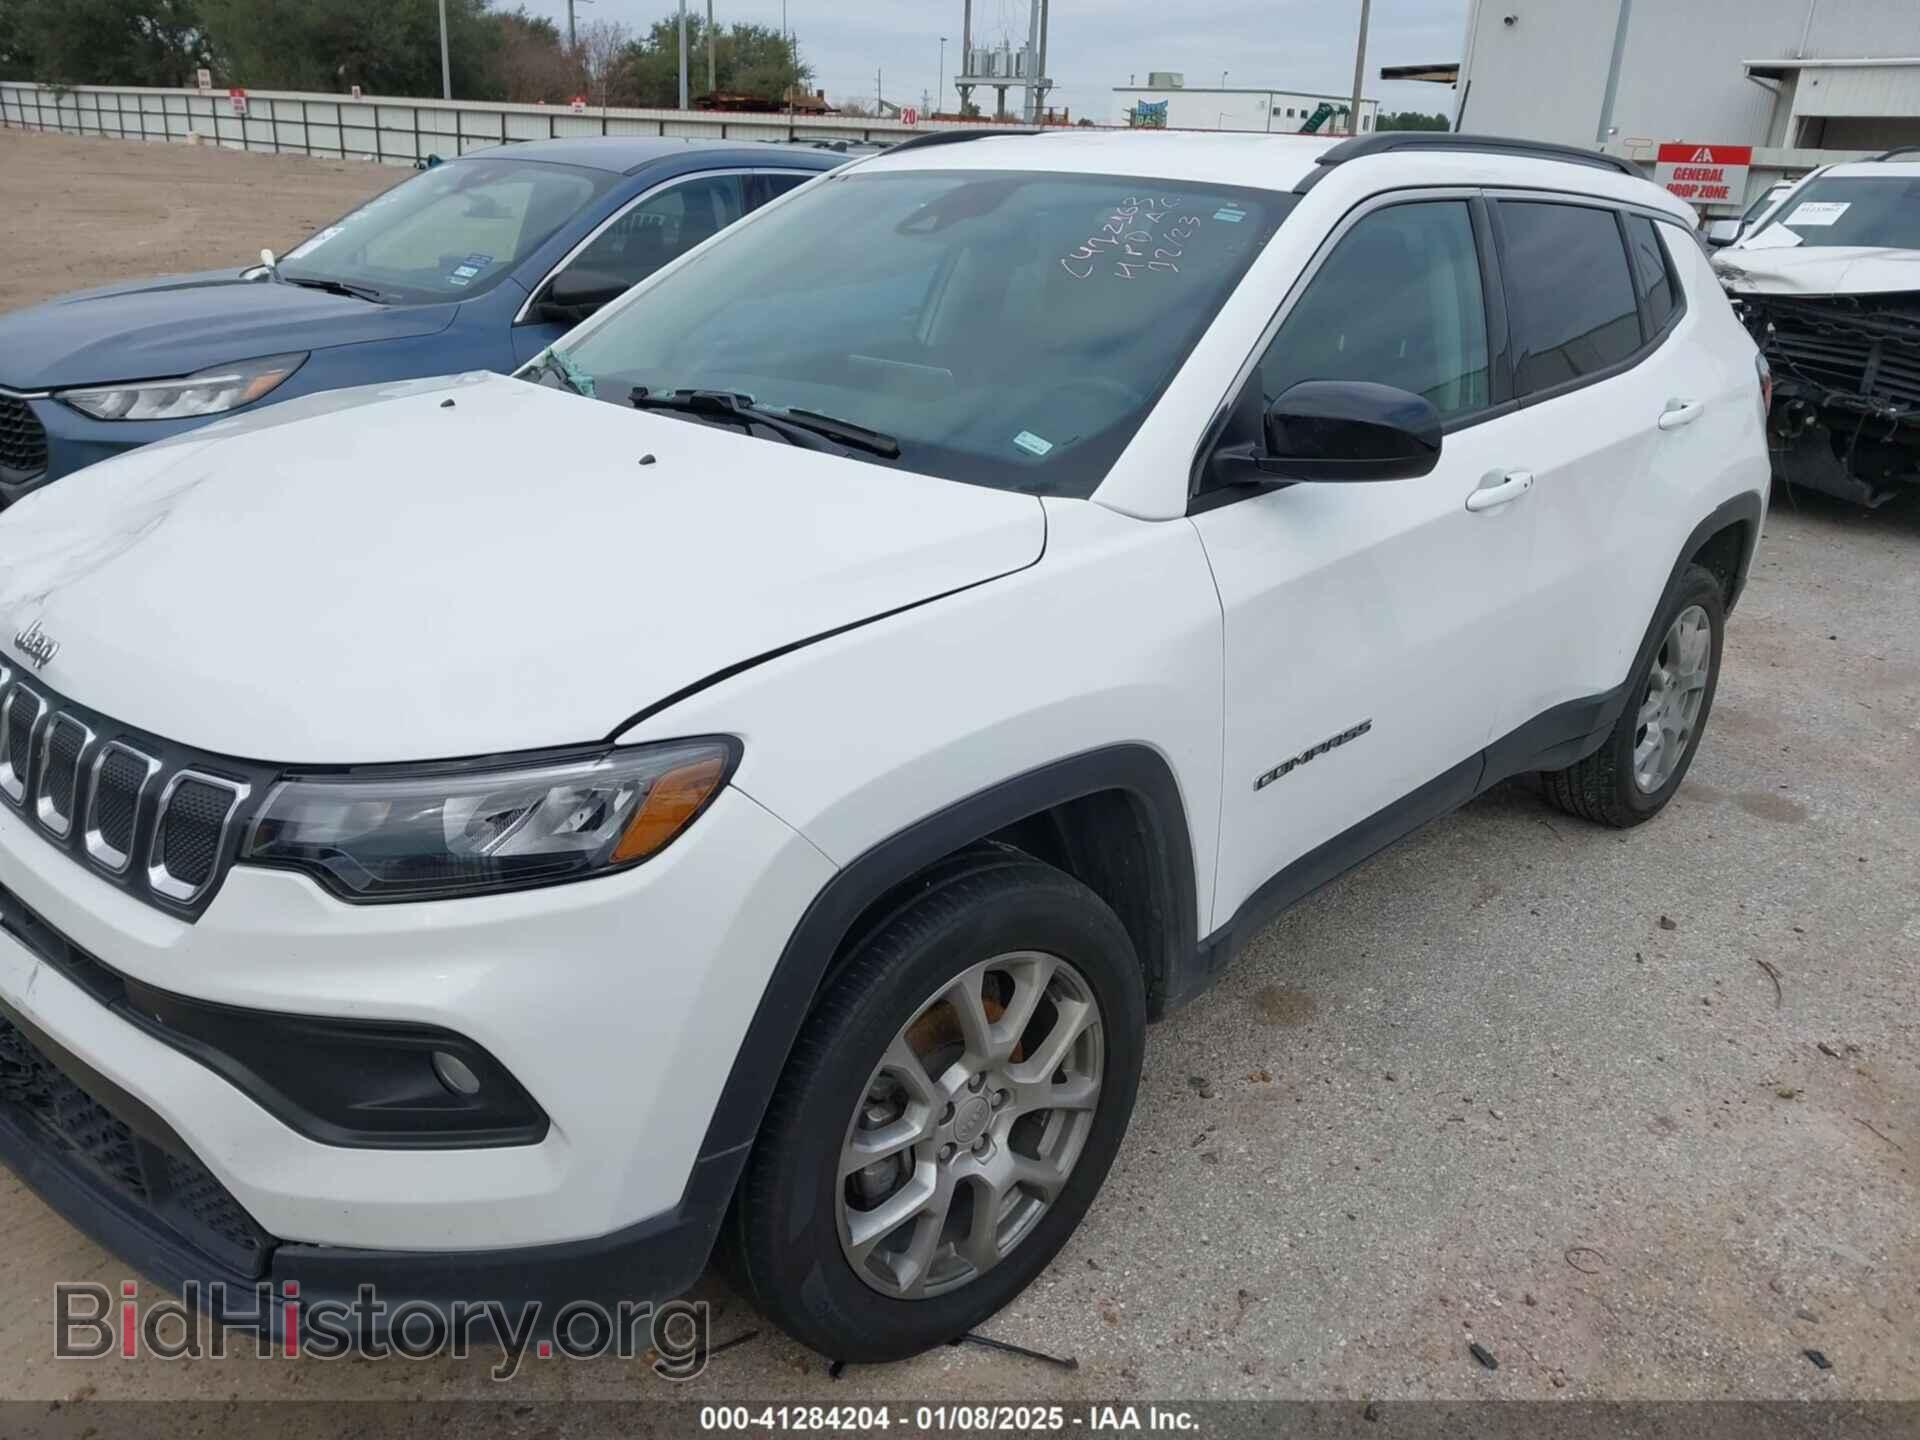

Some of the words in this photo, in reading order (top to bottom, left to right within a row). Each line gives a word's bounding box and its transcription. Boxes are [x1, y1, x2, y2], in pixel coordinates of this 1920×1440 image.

[902, 107, 916, 125] 20
[1673, 167, 1724, 182] GENERAL
[1697, 185, 1730, 199] ZONE
[14, 619, 59, 669] Jeep
[1253, 718, 1373, 792] COMPASS
